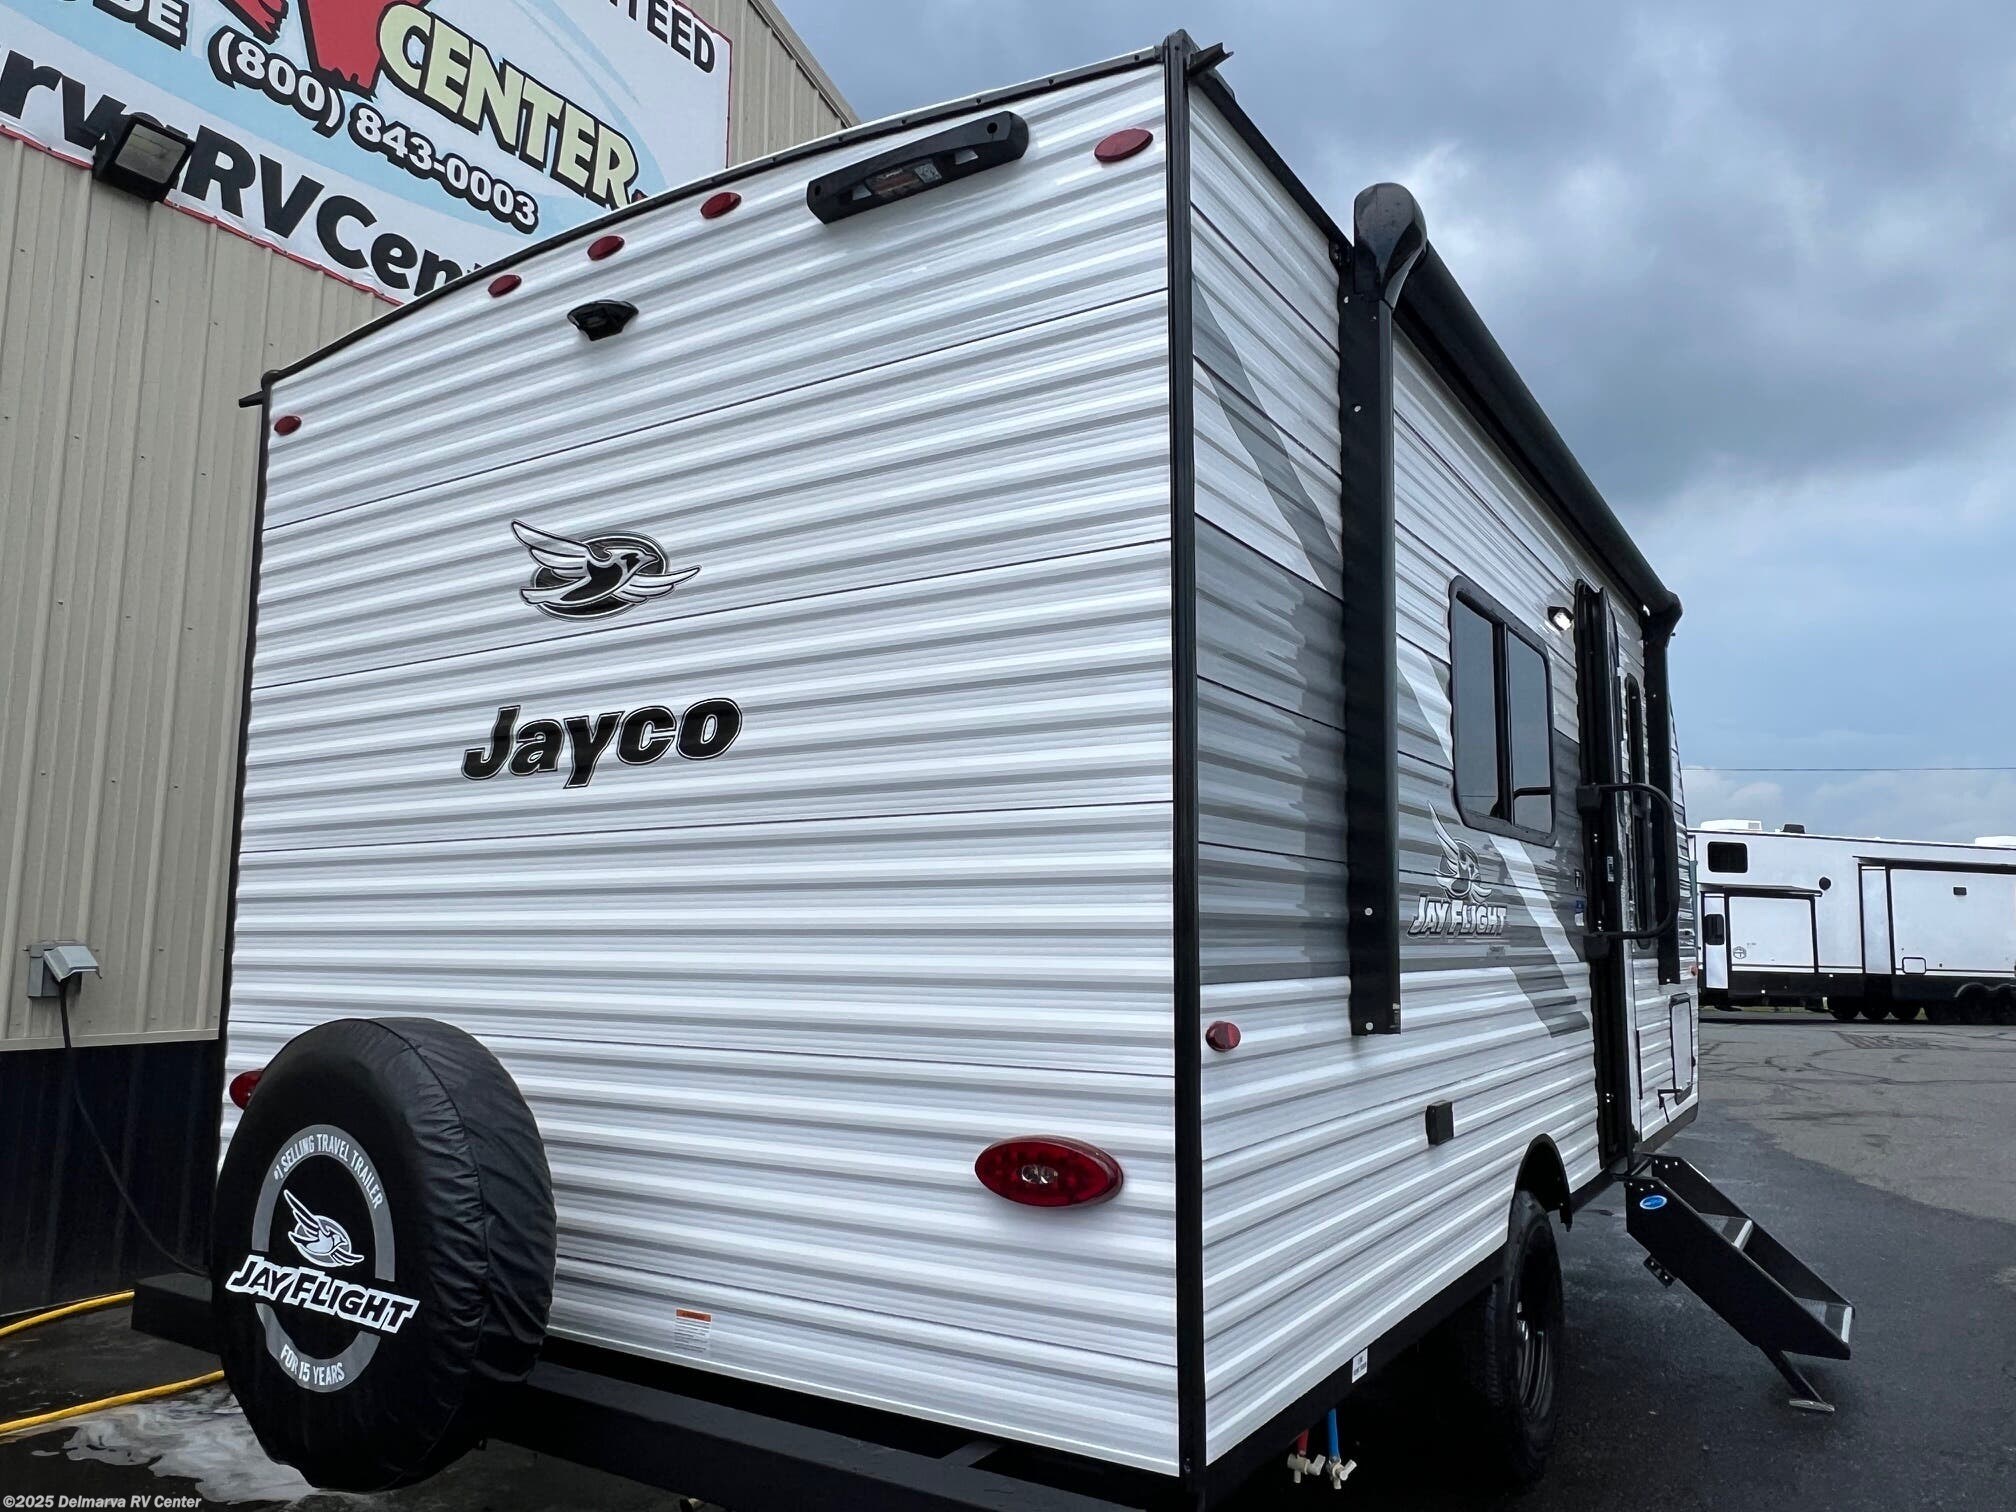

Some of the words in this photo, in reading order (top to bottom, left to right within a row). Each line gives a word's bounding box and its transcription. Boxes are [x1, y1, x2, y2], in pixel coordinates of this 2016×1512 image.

[211, 27, 344, 134] (800)
[352, 105, 538, 230] 843-0003
[377, 1, 638, 211] CENTER
[461, 697, 743, 789] Jayco
[280, 1134, 315, 1173] SELLING
[316, 1132, 351, 1163] TRAVEL
[349, 1149, 384, 1210] TRAILER
[280, 1343, 299, 1376] FOR
[299, 1360, 310, 1382] 15
[312, 1361, 345, 1385] YEARS
